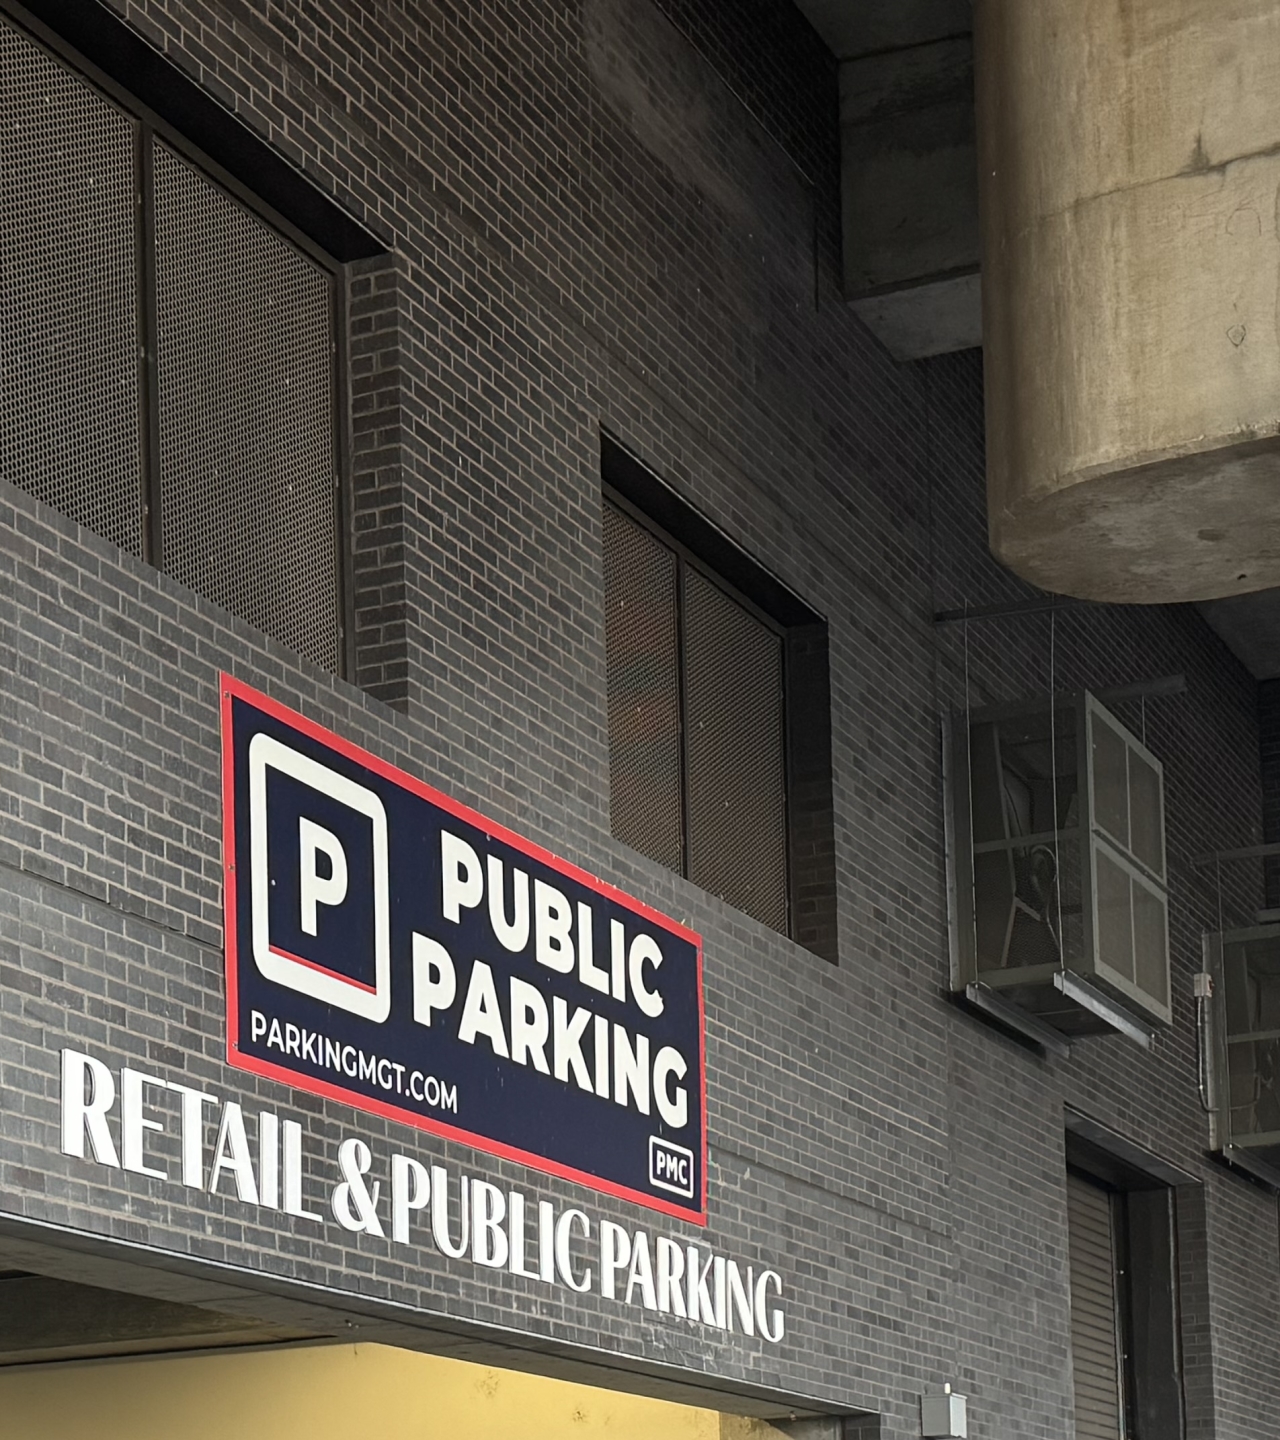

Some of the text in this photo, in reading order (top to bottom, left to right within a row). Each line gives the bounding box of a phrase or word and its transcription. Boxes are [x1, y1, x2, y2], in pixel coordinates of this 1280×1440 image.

[298, 815, 349, 938] P
[440, 829, 664, 1018] PUBLIC
[250, 1009, 458, 1115] PARKINGMGT.COM
[411, 931, 690, 1130] PARKING
[59, 1048, 786, 1344] RETAIL & PUBLIC PARKING
[656, 1149, 688, 1185] PMC
